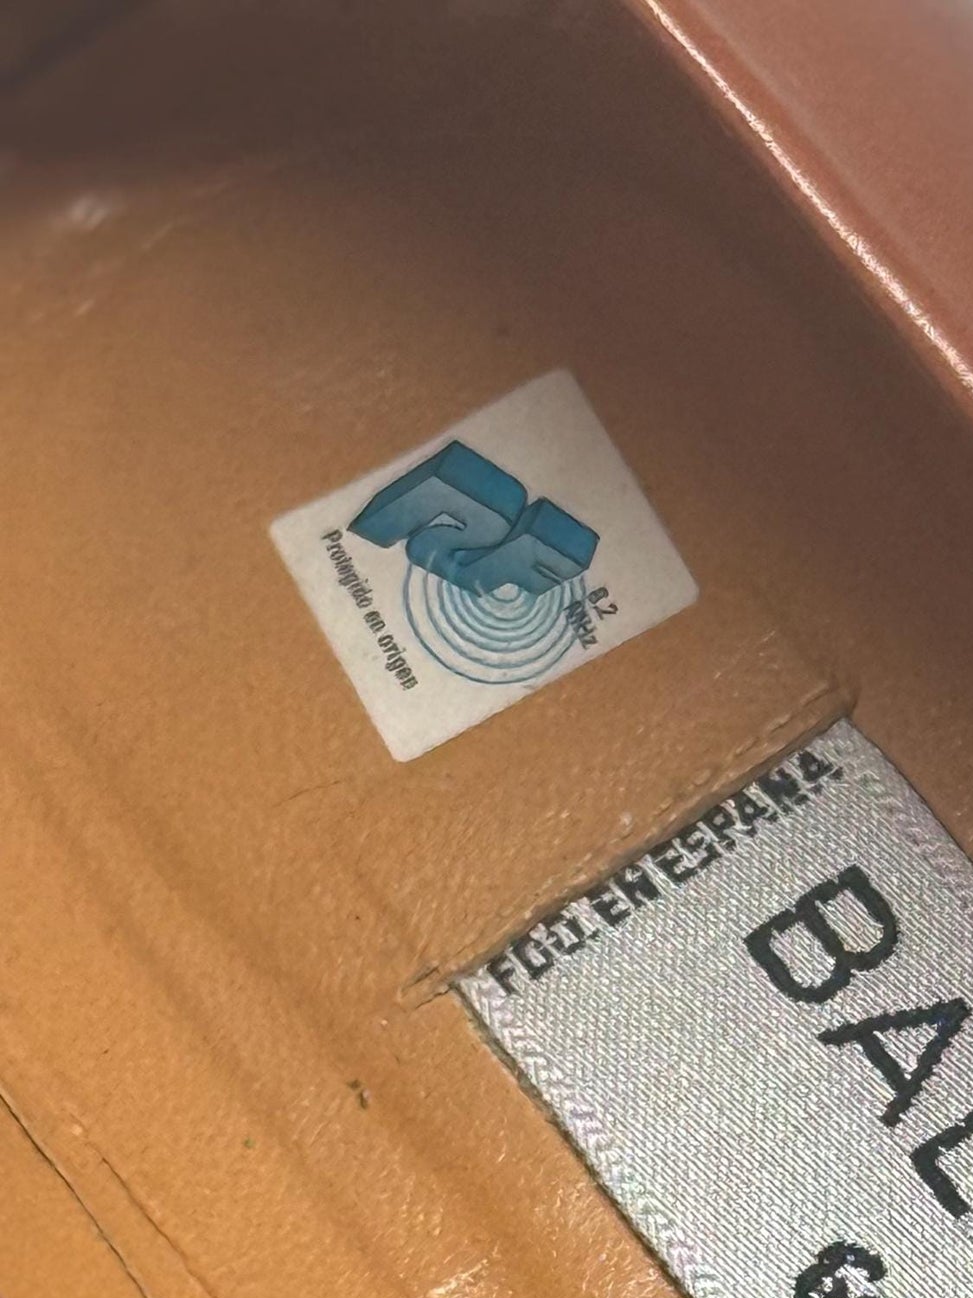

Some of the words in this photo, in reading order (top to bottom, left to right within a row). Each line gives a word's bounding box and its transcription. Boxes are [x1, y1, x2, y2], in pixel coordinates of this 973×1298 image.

[321, 528, 373, 609] Protegido
[363, 611, 386, 634] en
[377, 634, 418, 691] origen
[563, 600, 597, 650] MHz
